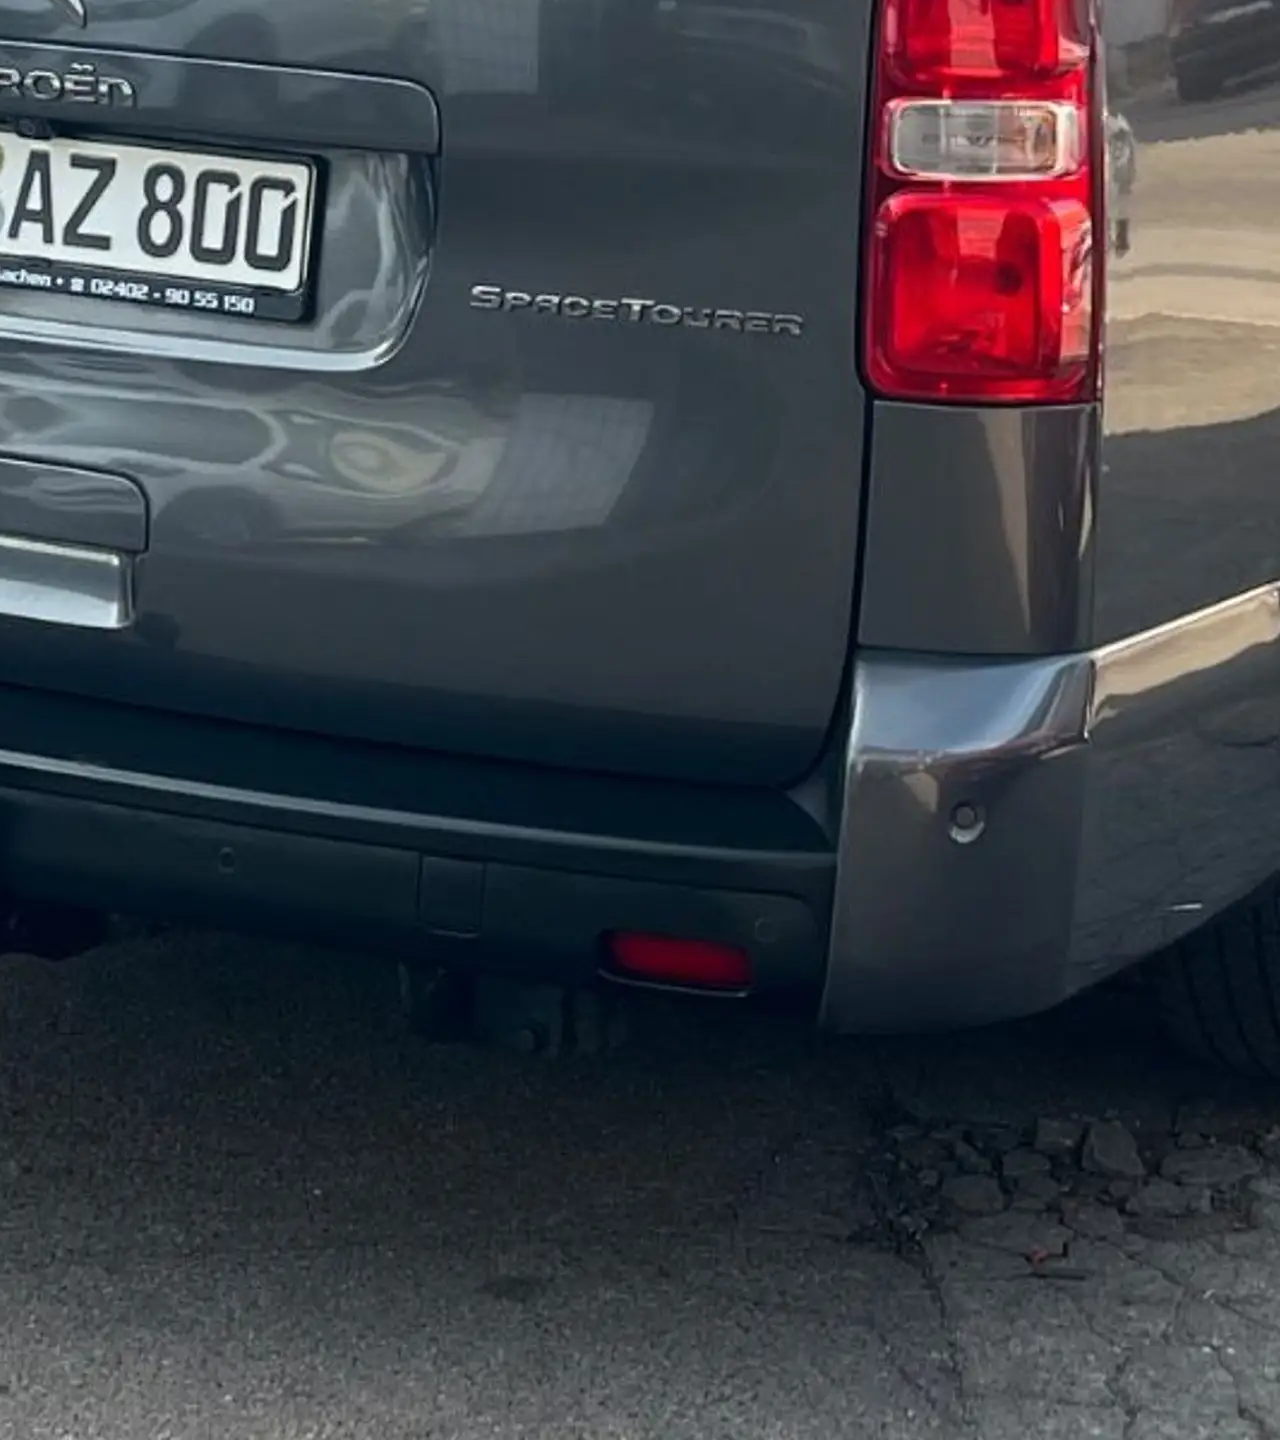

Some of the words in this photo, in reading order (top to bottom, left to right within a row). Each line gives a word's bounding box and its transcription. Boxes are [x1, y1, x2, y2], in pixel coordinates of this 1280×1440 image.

[8, 149, 118, 250] AZ
[136, 162, 298, 273] 800
[90, 278, 150, 300] 02402
[164, 286, 190, 305] 90
[193, 290, 219, 310] 55
[223, 294, 255, 315] 150
